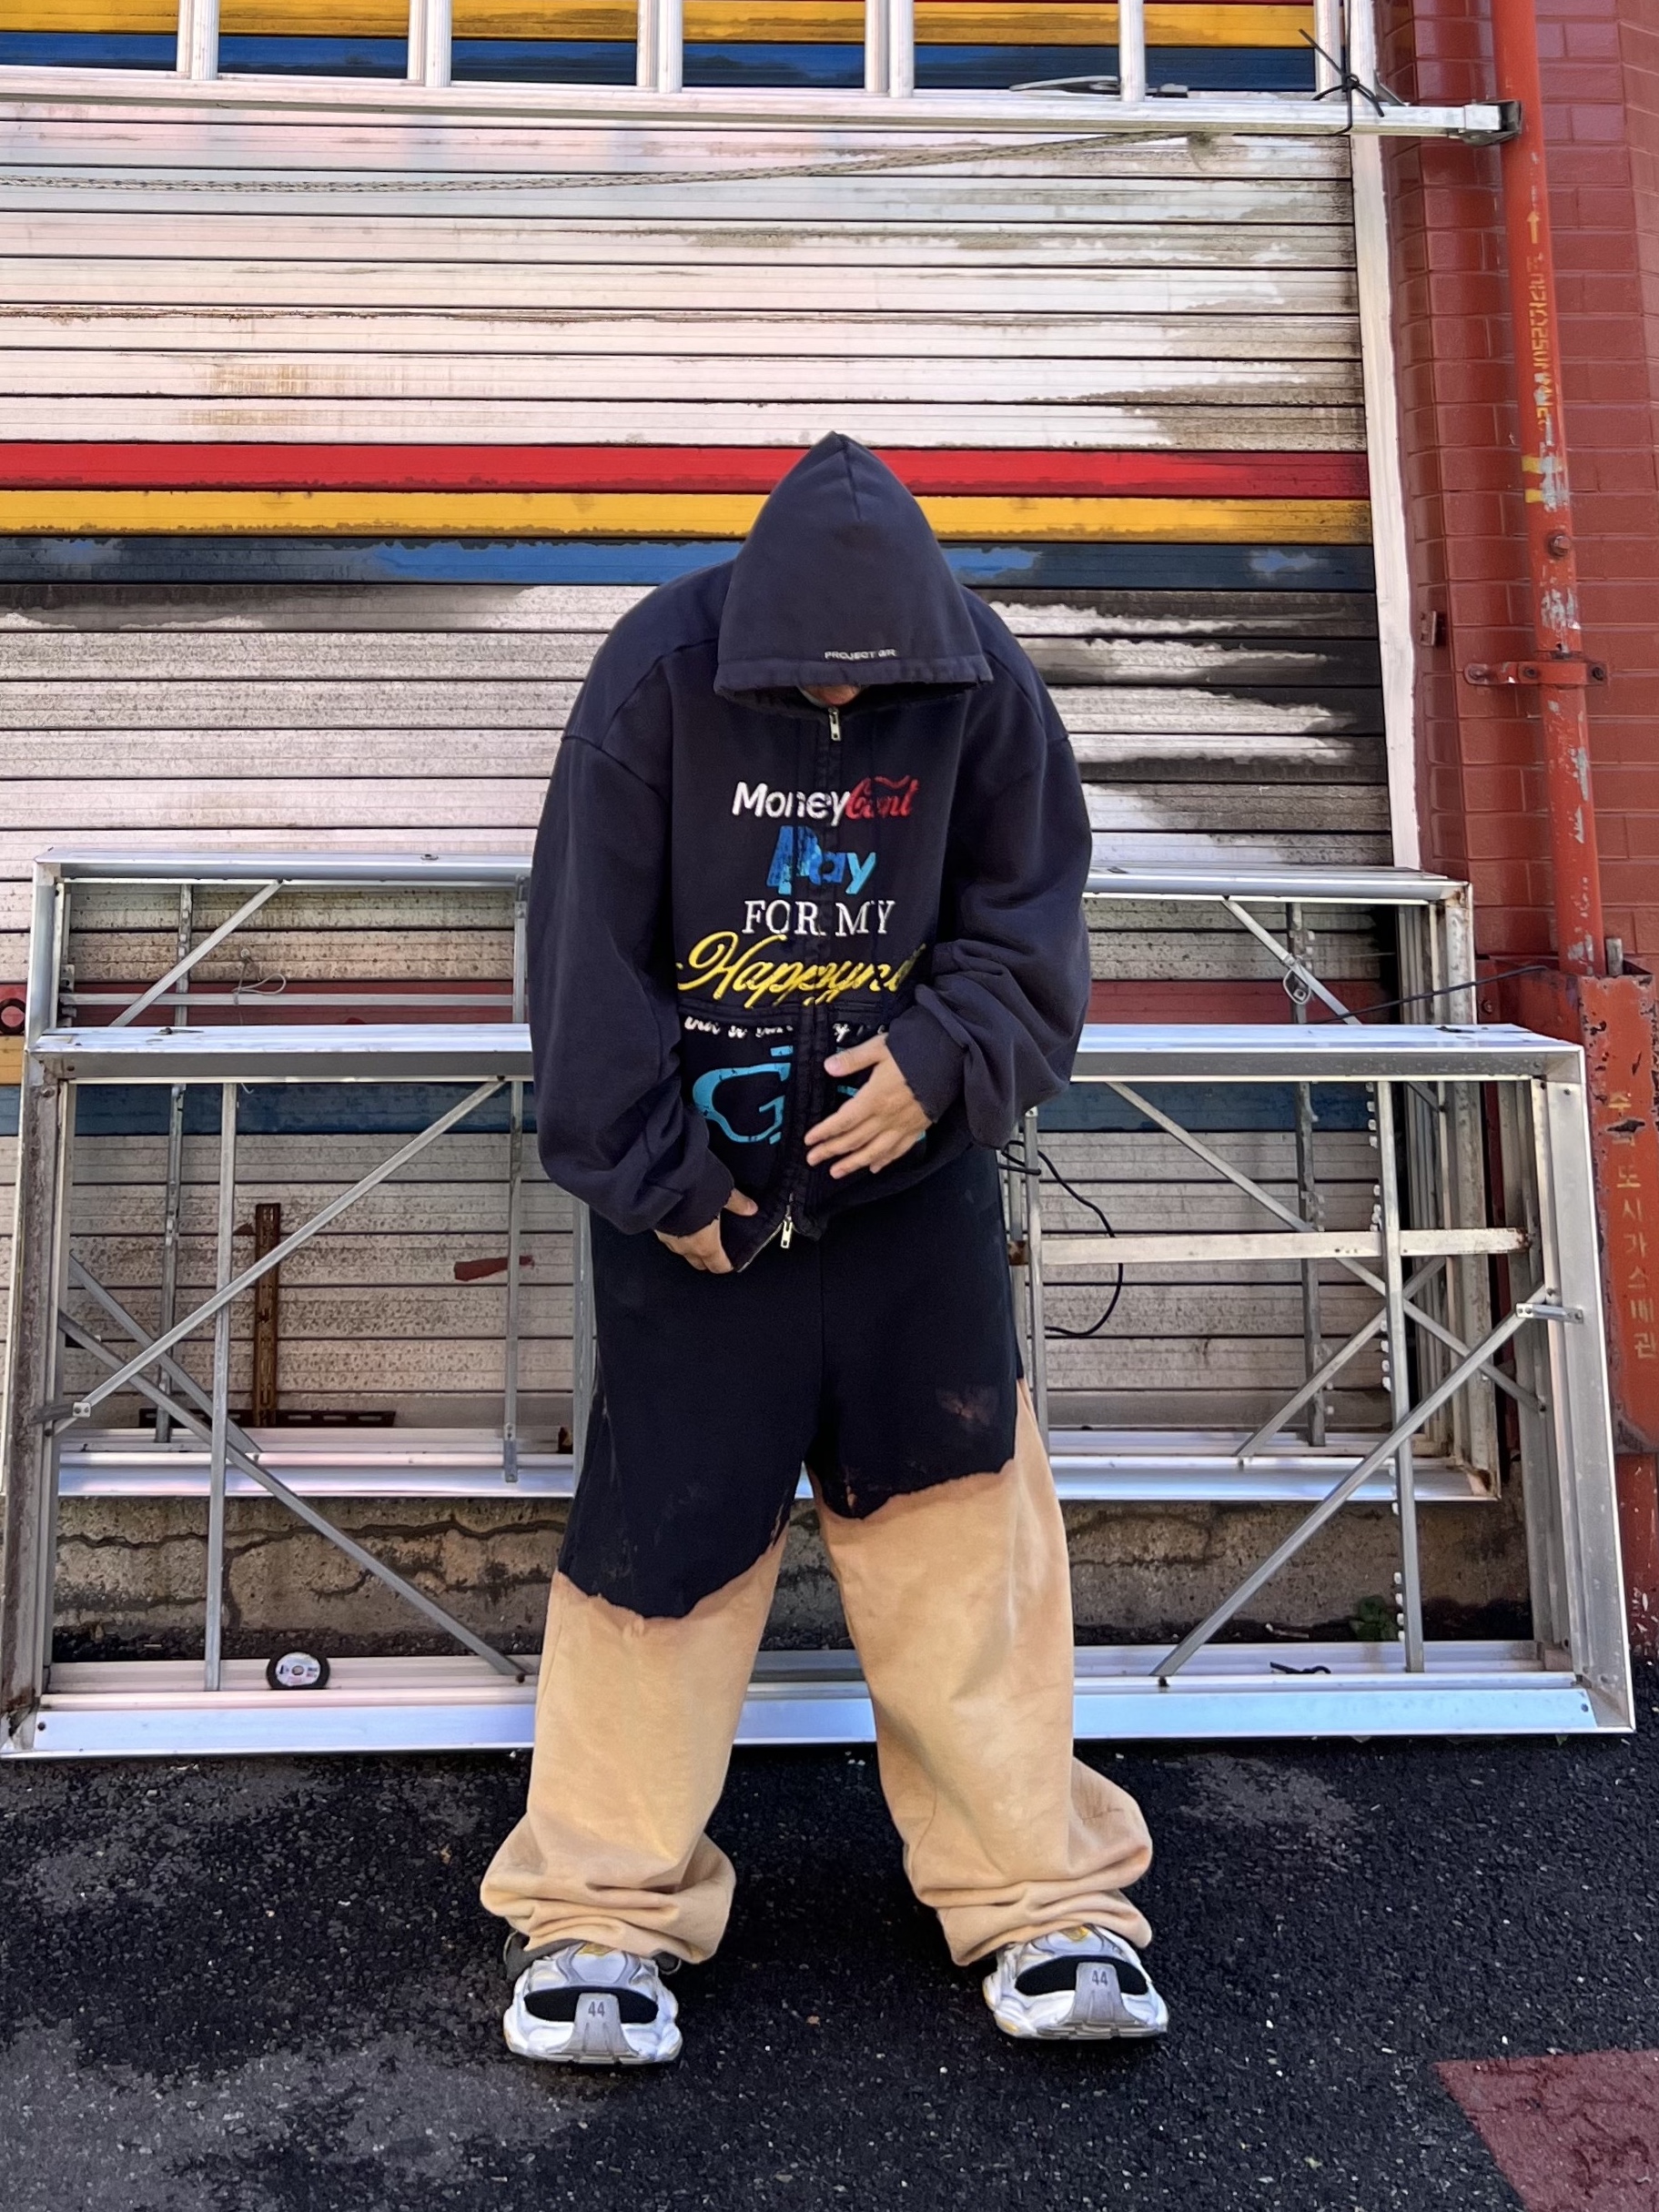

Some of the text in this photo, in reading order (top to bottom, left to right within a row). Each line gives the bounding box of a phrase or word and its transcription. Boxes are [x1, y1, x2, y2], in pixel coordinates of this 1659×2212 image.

[824, 651, 875, 662] PROJECT
[732, 781, 851, 827] Money
[742, 899, 895, 937] FOR MY
[1091, 1969, 1108, 1985] 44
[588, 2001, 605, 2017] 44
